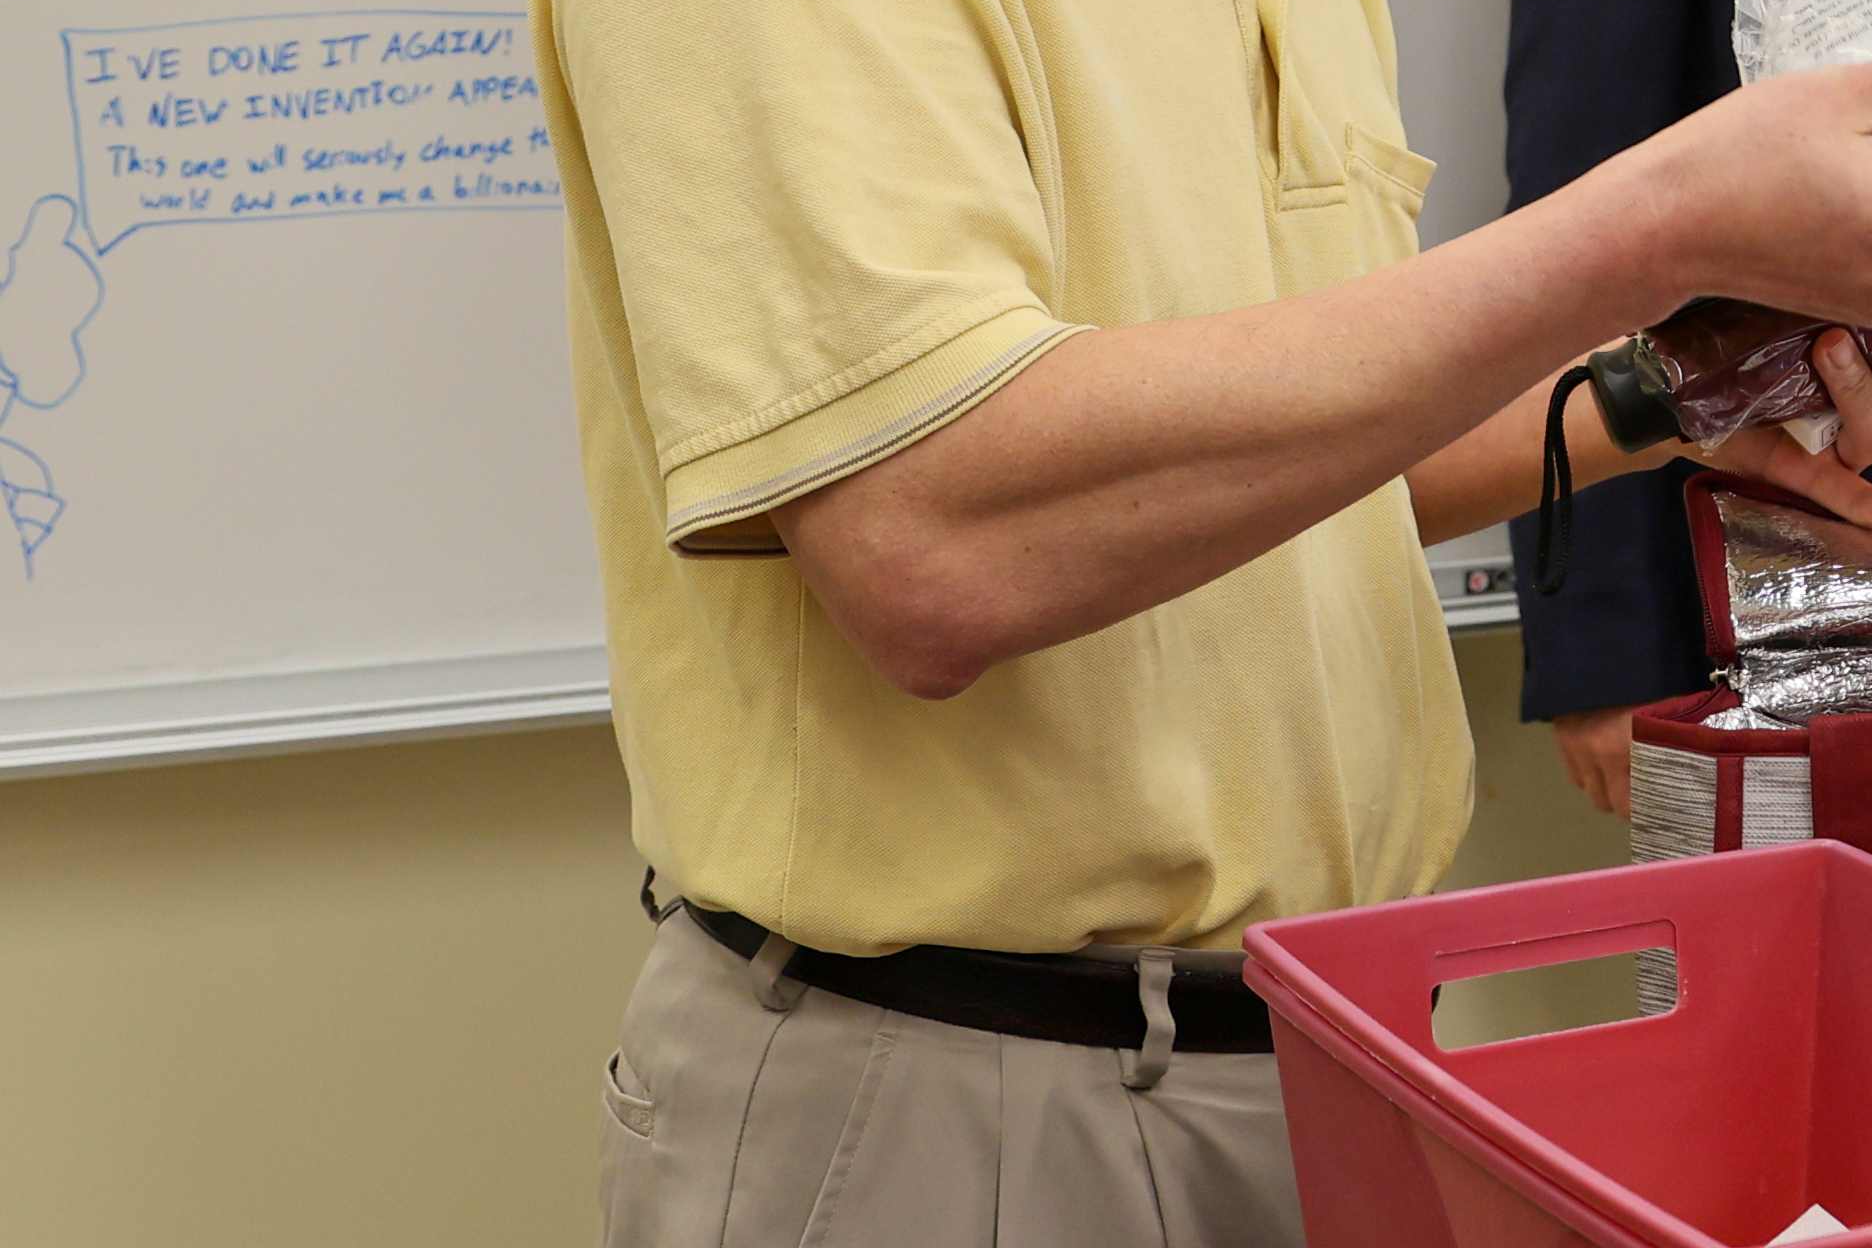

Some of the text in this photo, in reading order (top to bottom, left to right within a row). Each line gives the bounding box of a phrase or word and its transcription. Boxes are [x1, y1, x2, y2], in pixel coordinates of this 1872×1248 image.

[207, 41, 300, 77] DONE
[320, 33, 371, 68] IT
[380, 28, 513, 64] AGAIN!
[100, 96, 125, 128] A
[147, 96, 229, 128] NEW
[447, 74, 539, 105] APPEA
[107, 144, 168, 177] This
[180, 156, 229, 179] one
[302, 139, 405, 170] seriously
[419, 132, 514, 164] change
[139, 187, 212, 211] world
[289, 183, 364, 208] make
[376, 189, 408, 205] me
[417, 186, 435, 202] a
